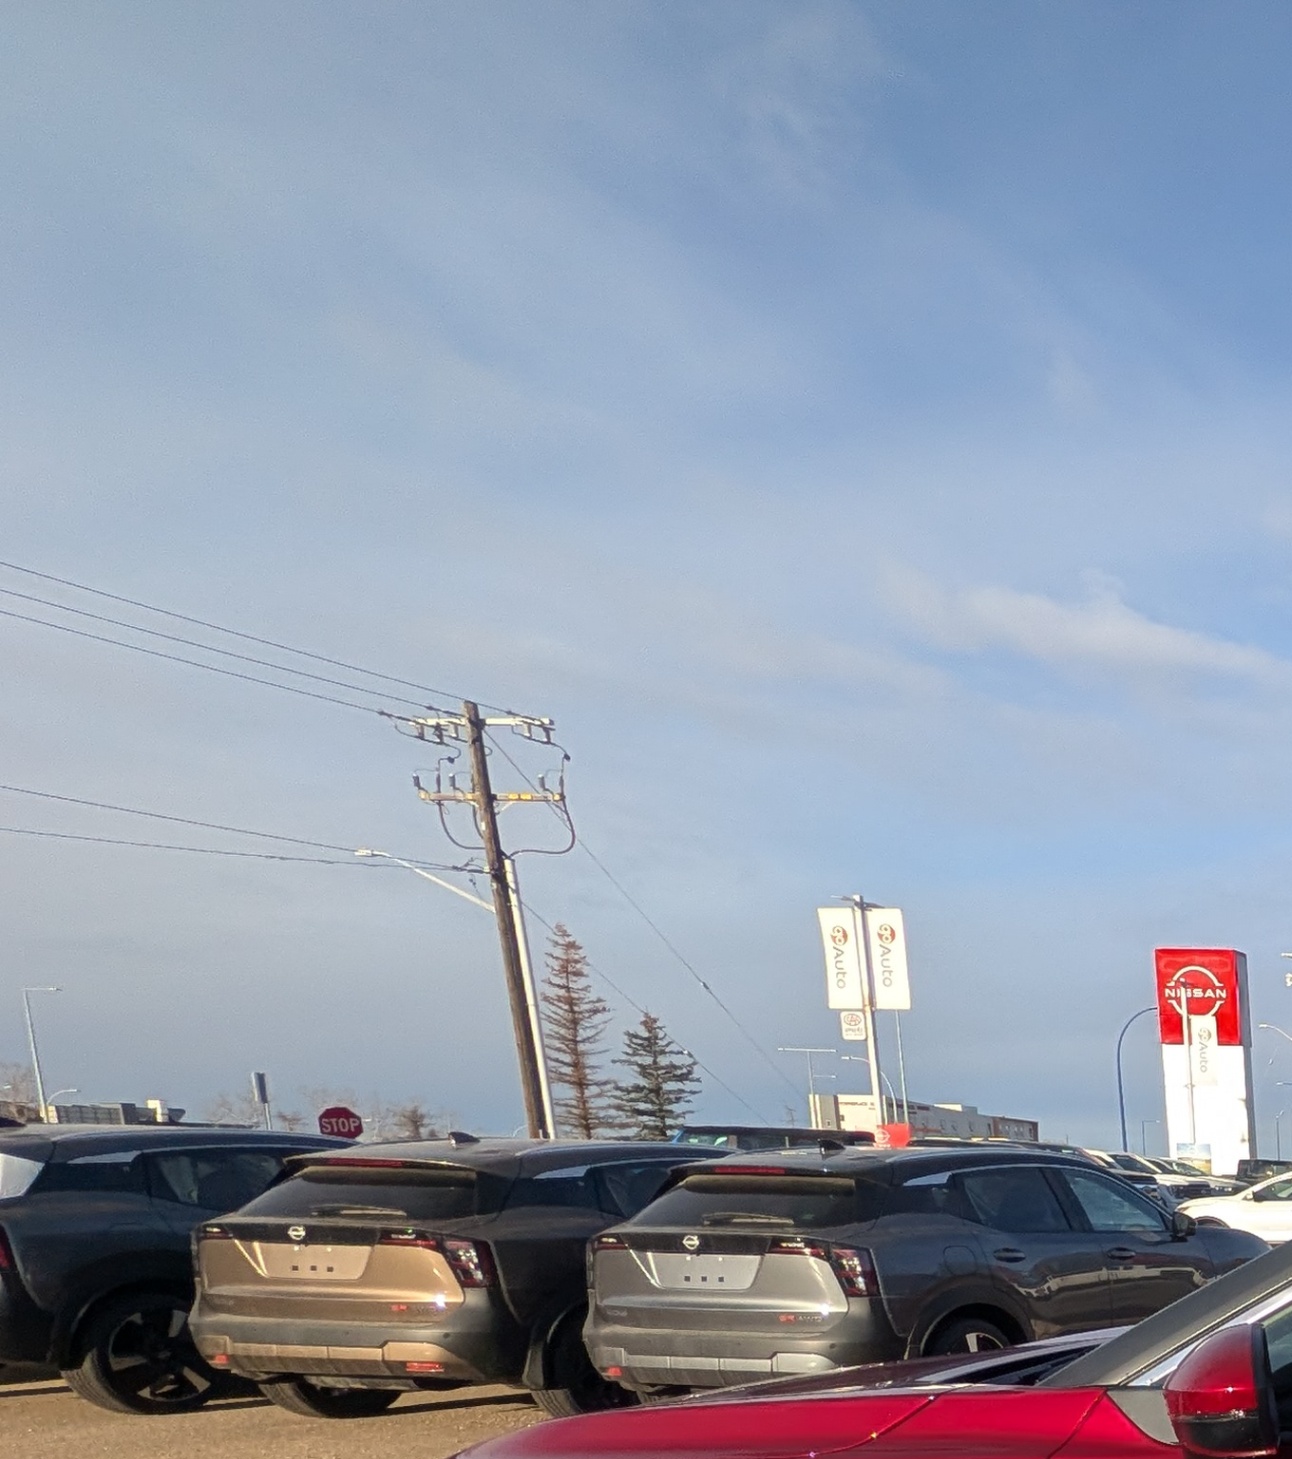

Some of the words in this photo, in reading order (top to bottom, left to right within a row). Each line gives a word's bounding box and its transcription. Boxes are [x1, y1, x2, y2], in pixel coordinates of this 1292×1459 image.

[832, 946, 847, 989] Auto
[879, 944, 894, 987] Auto
[1199, 1041, 1209, 1073] Auto
[321, 1117, 360, 1133] STOP
